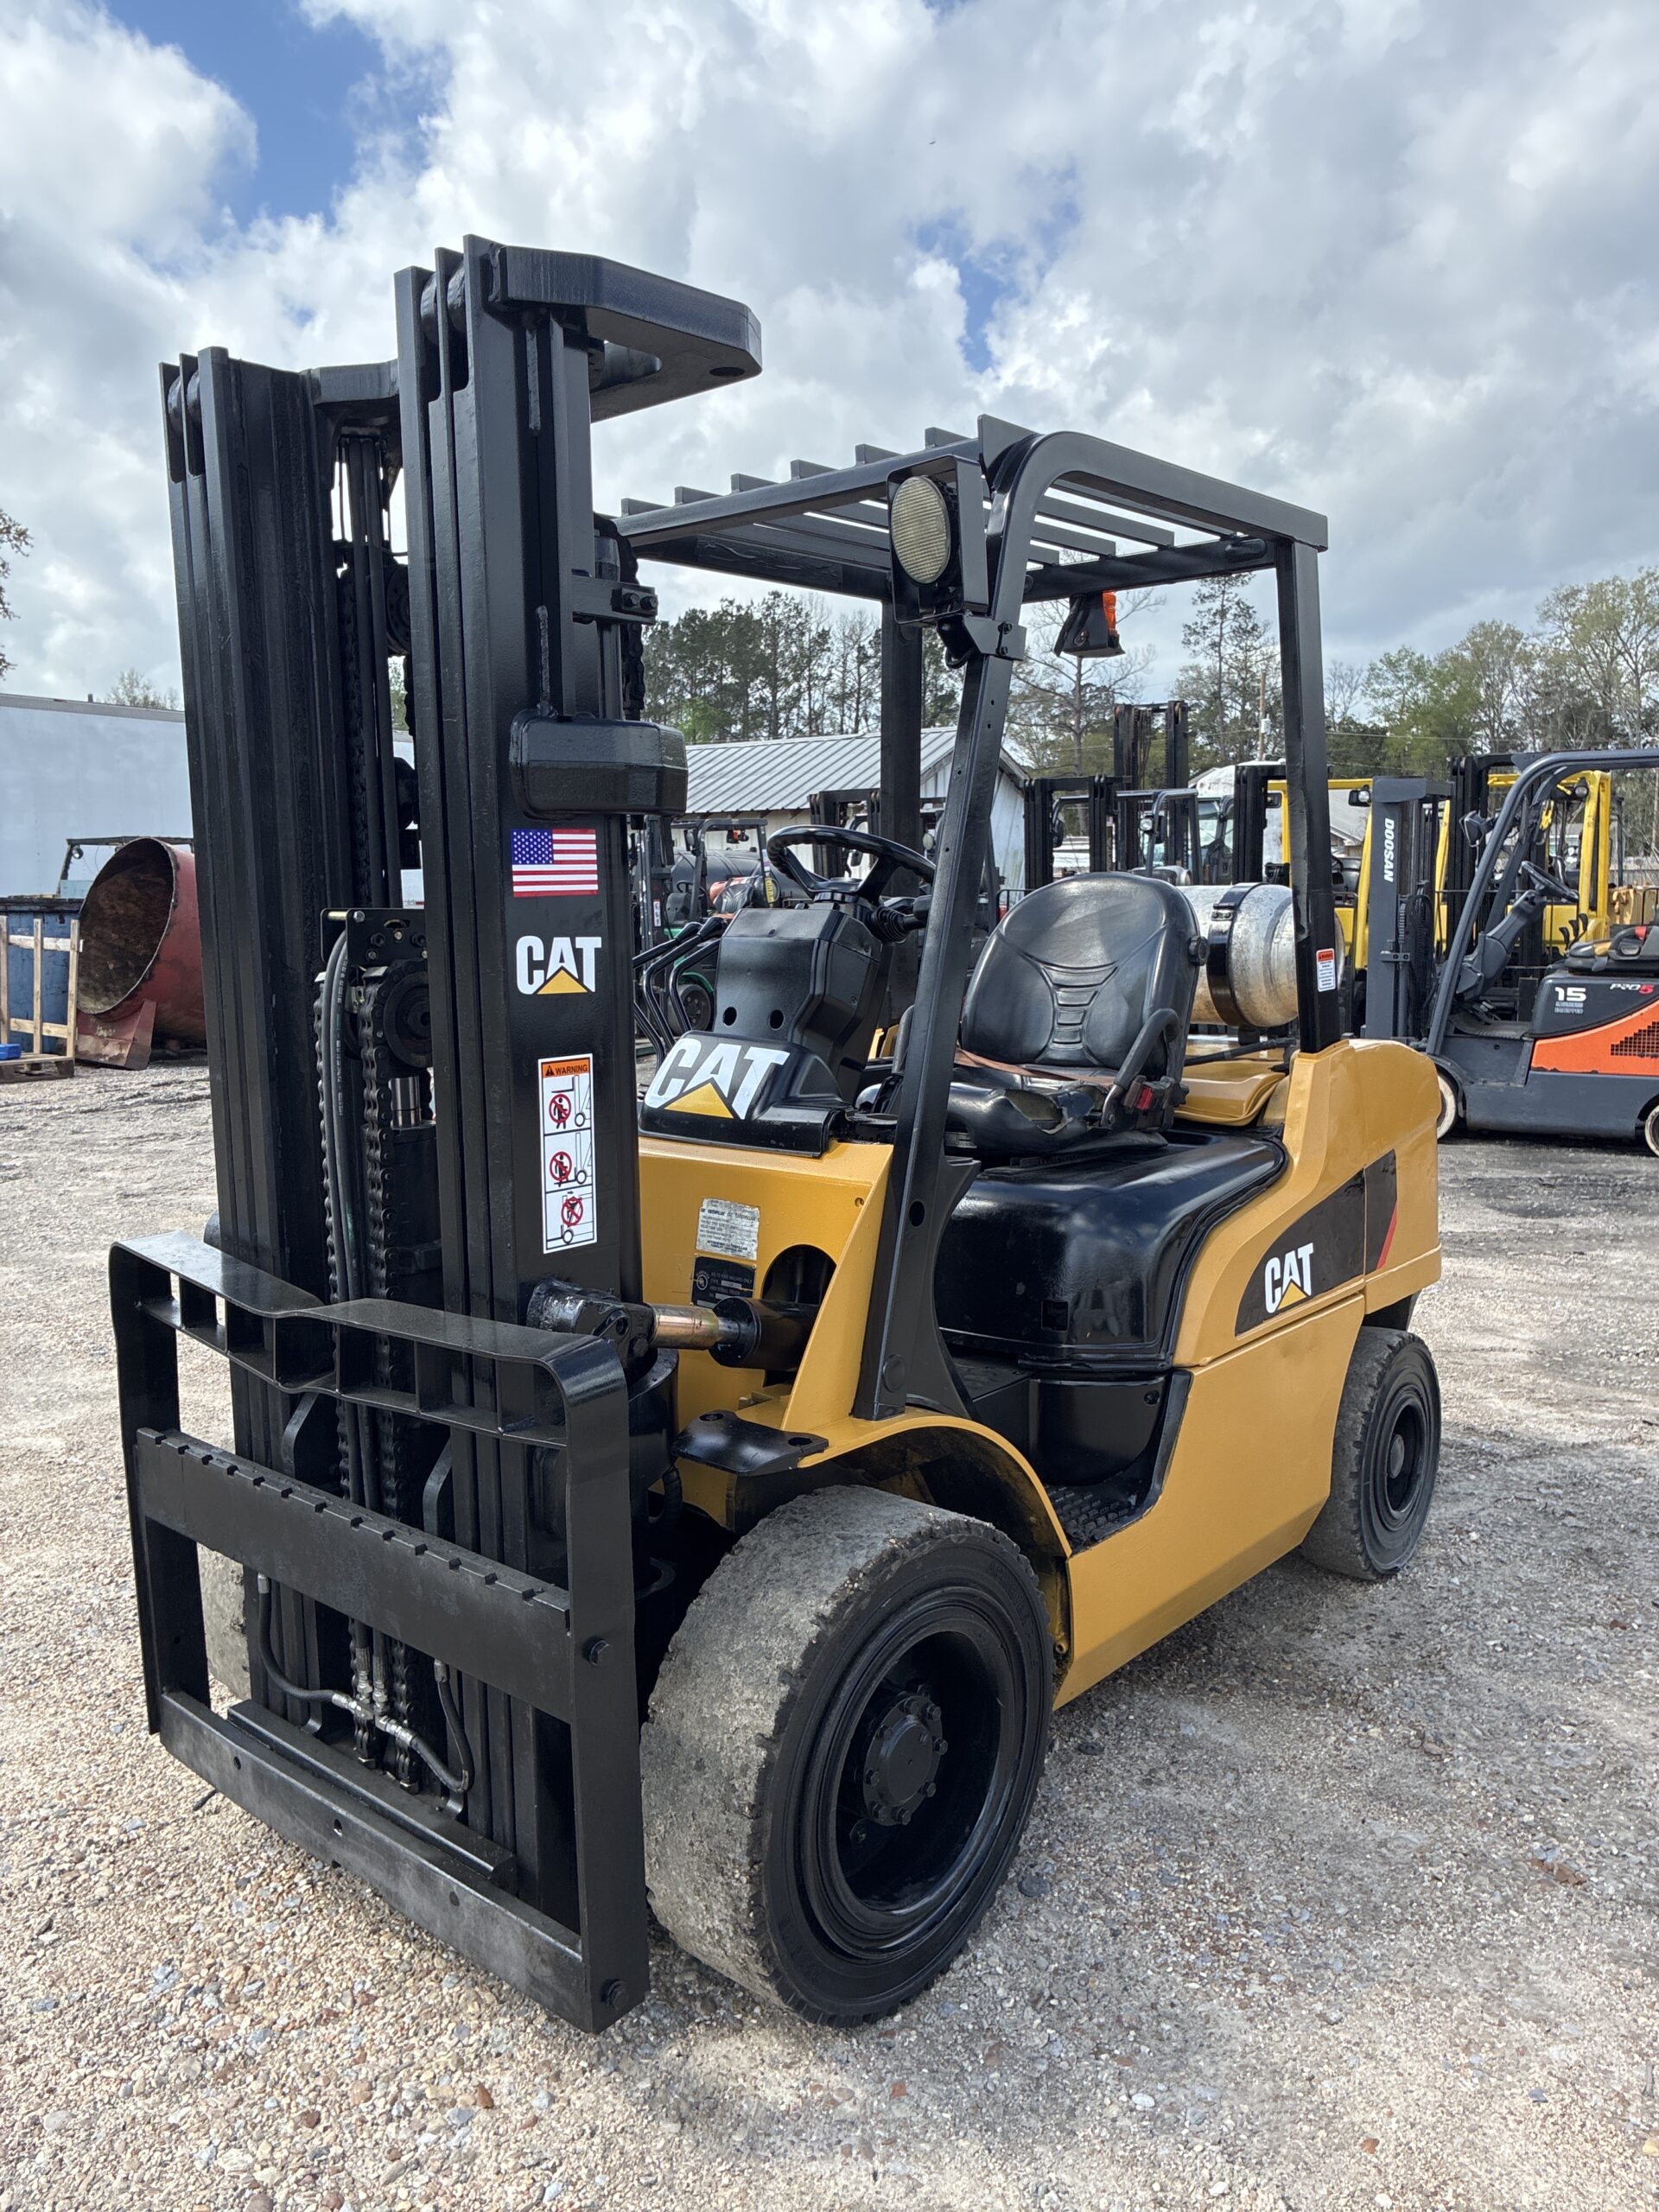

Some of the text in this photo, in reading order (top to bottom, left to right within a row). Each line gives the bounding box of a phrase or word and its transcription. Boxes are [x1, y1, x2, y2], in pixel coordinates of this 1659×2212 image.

[1384, 817, 1395, 883] DOOSAN
[516, 935, 602, 995] CAT
[1554, 987, 1586, 1001] 15
[556, 1064, 588, 1076] WARNING
[644, 1038, 791, 1120] CAT
[1264, 1243, 1314, 1313] CAT
